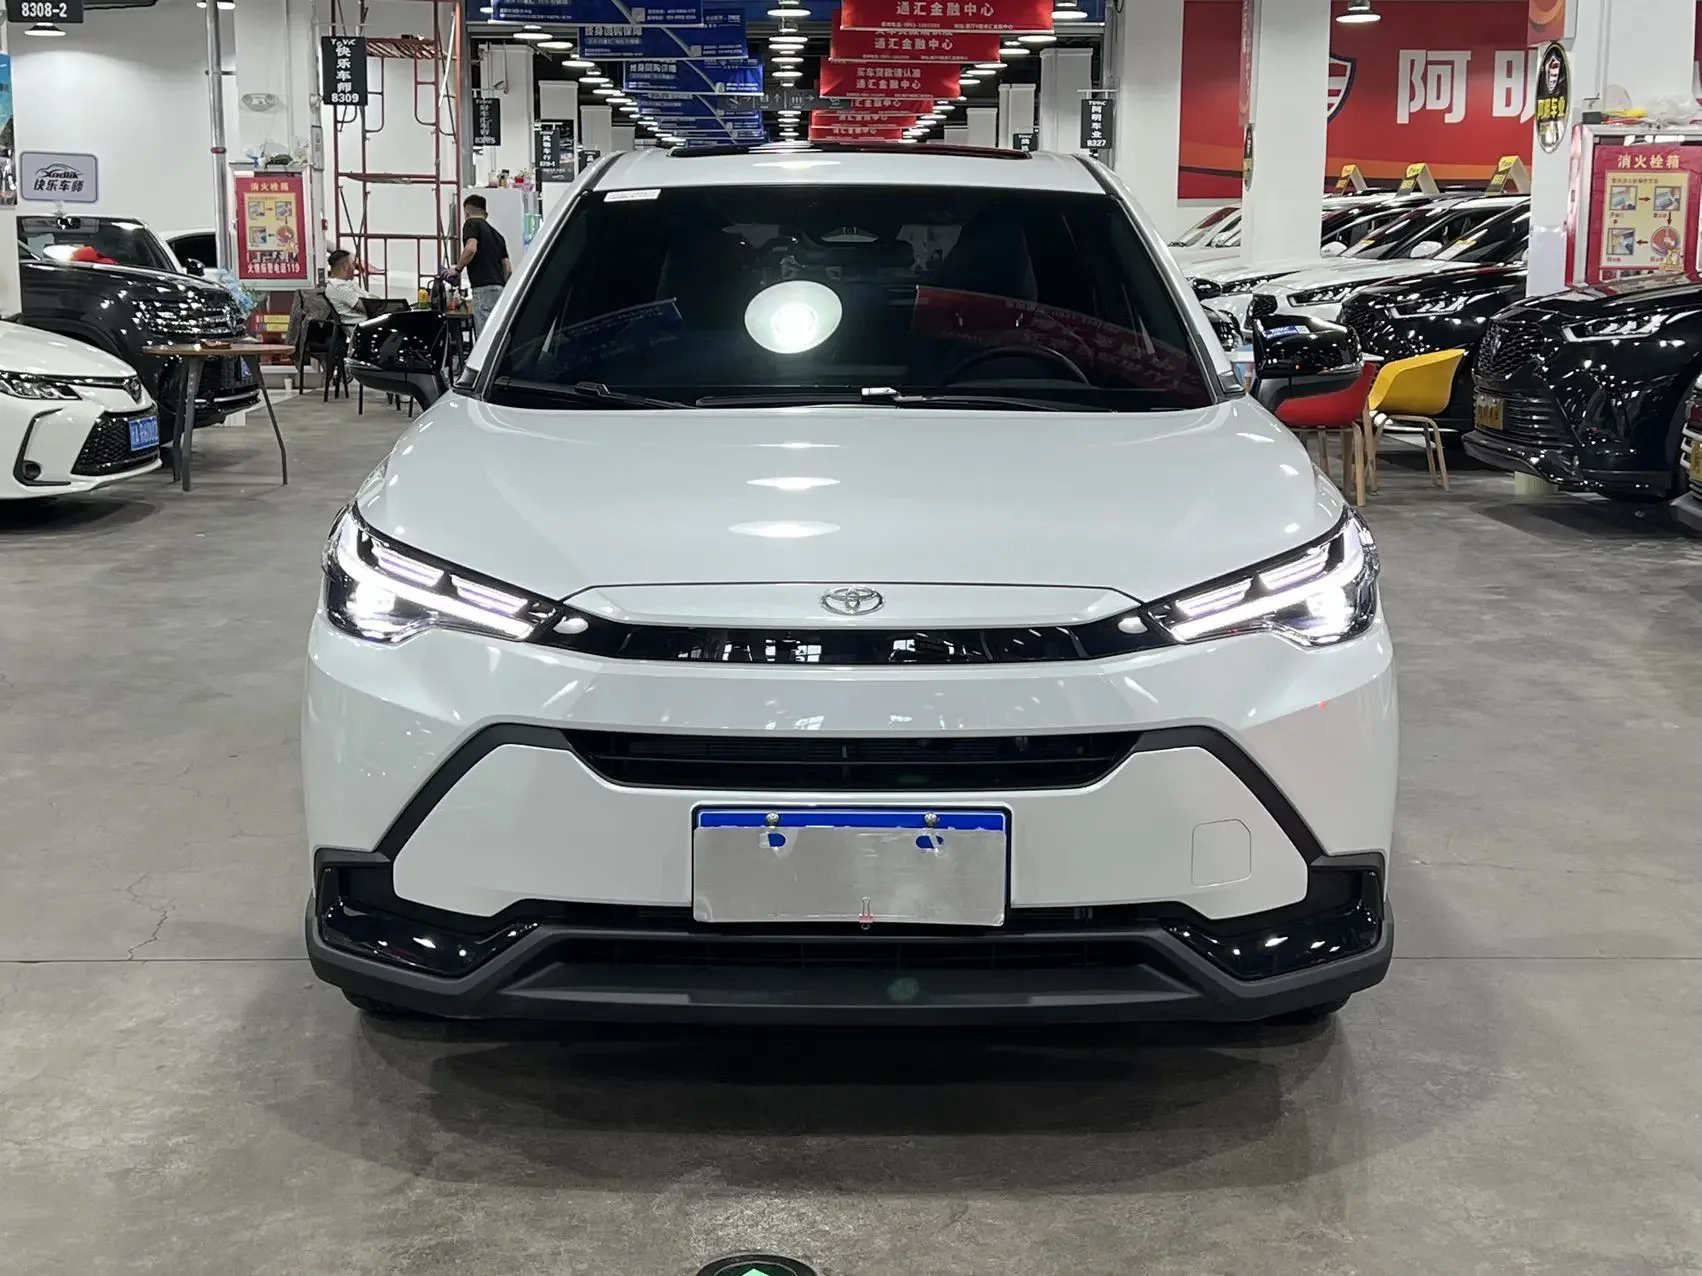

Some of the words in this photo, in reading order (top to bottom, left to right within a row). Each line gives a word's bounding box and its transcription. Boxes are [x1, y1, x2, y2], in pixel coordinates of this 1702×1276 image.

[21, 2, 68, 17] 8308-2
[896, 1, 995, 17] 通汇金融中心
[874, 38, 953, 51] 通汇金融中心
[335, 46, 352, 92] 快乐车师
[856, 67, 922, 78] 买车贷款请认准
[856, 79, 921, 89] 通汇金融中心
[331, 93, 360, 103] 8309
[1086, 139, 1107, 147] 8327
[1617, 154, 1681, 169] 消火栓箱
[33, 178, 85, 192] 快乐车师
[250, 182, 289, 191] 消火栓箱
